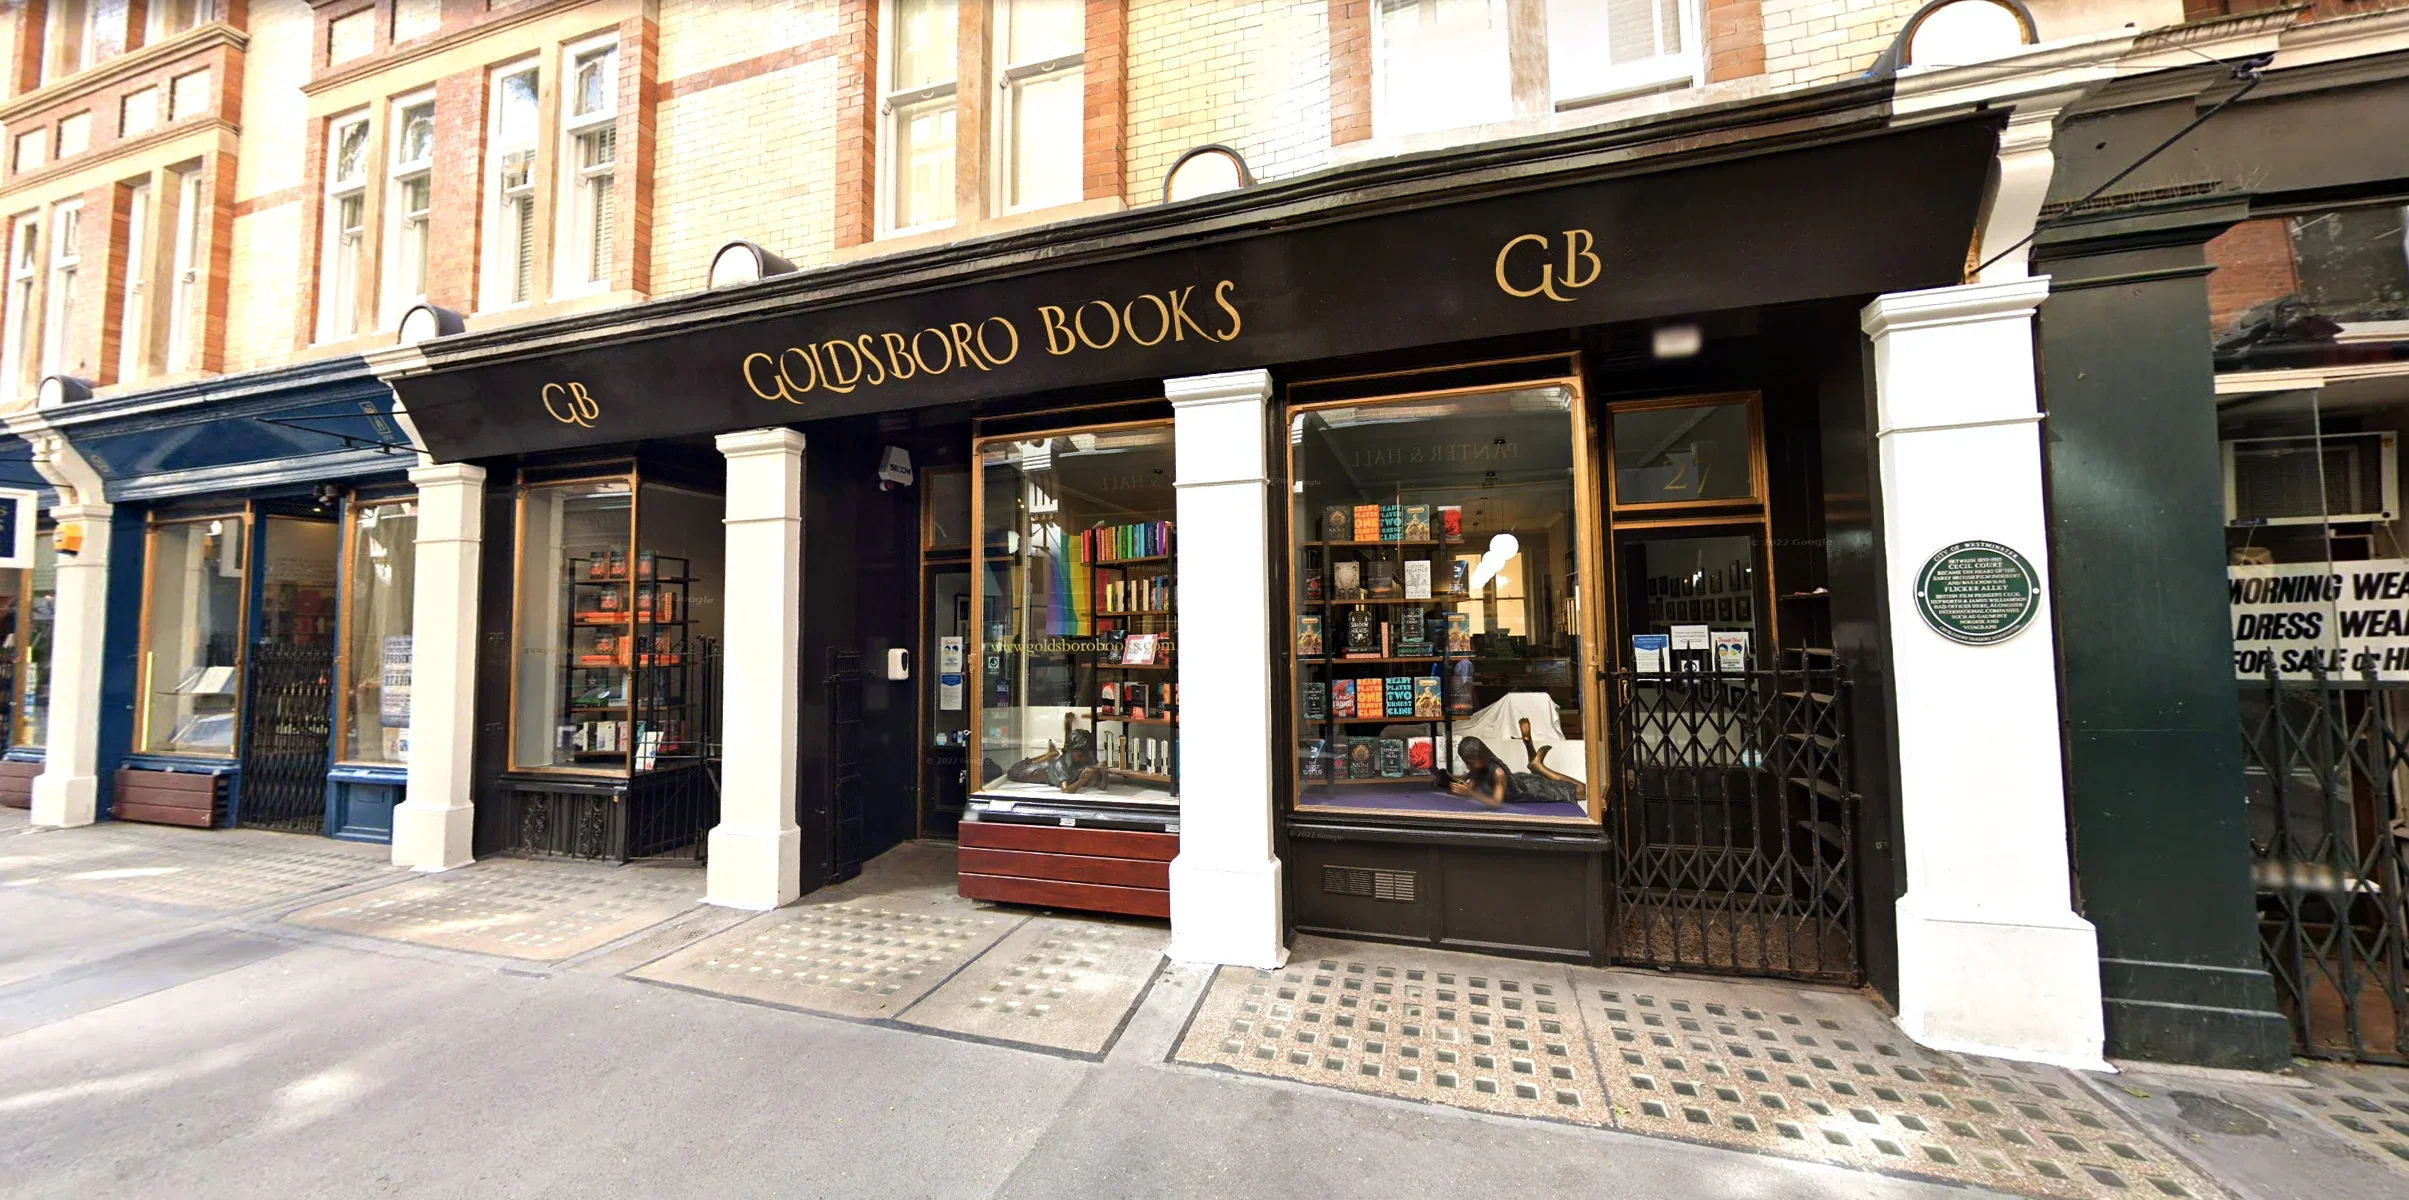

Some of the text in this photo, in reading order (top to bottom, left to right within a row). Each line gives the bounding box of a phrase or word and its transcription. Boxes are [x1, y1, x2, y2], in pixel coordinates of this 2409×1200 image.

[1496, 230, 1601, 301] GB
[744, 280, 1241, 404] GOLDSBORO BOOKS
[543, 382, 599, 427] GB
[1934, 550, 1948, 561] CITY
[1964, 542, 2018, 559] WESTMINSTER
[2236, 612, 2323, 641] DRESS
[991, 639, 1176, 656] www.goldsboroboos.com
[1357, 692, 1383, 702] ONE
[1387, 691, 1412, 700] TWO
[1388, 707, 1413, 715] CLINE
